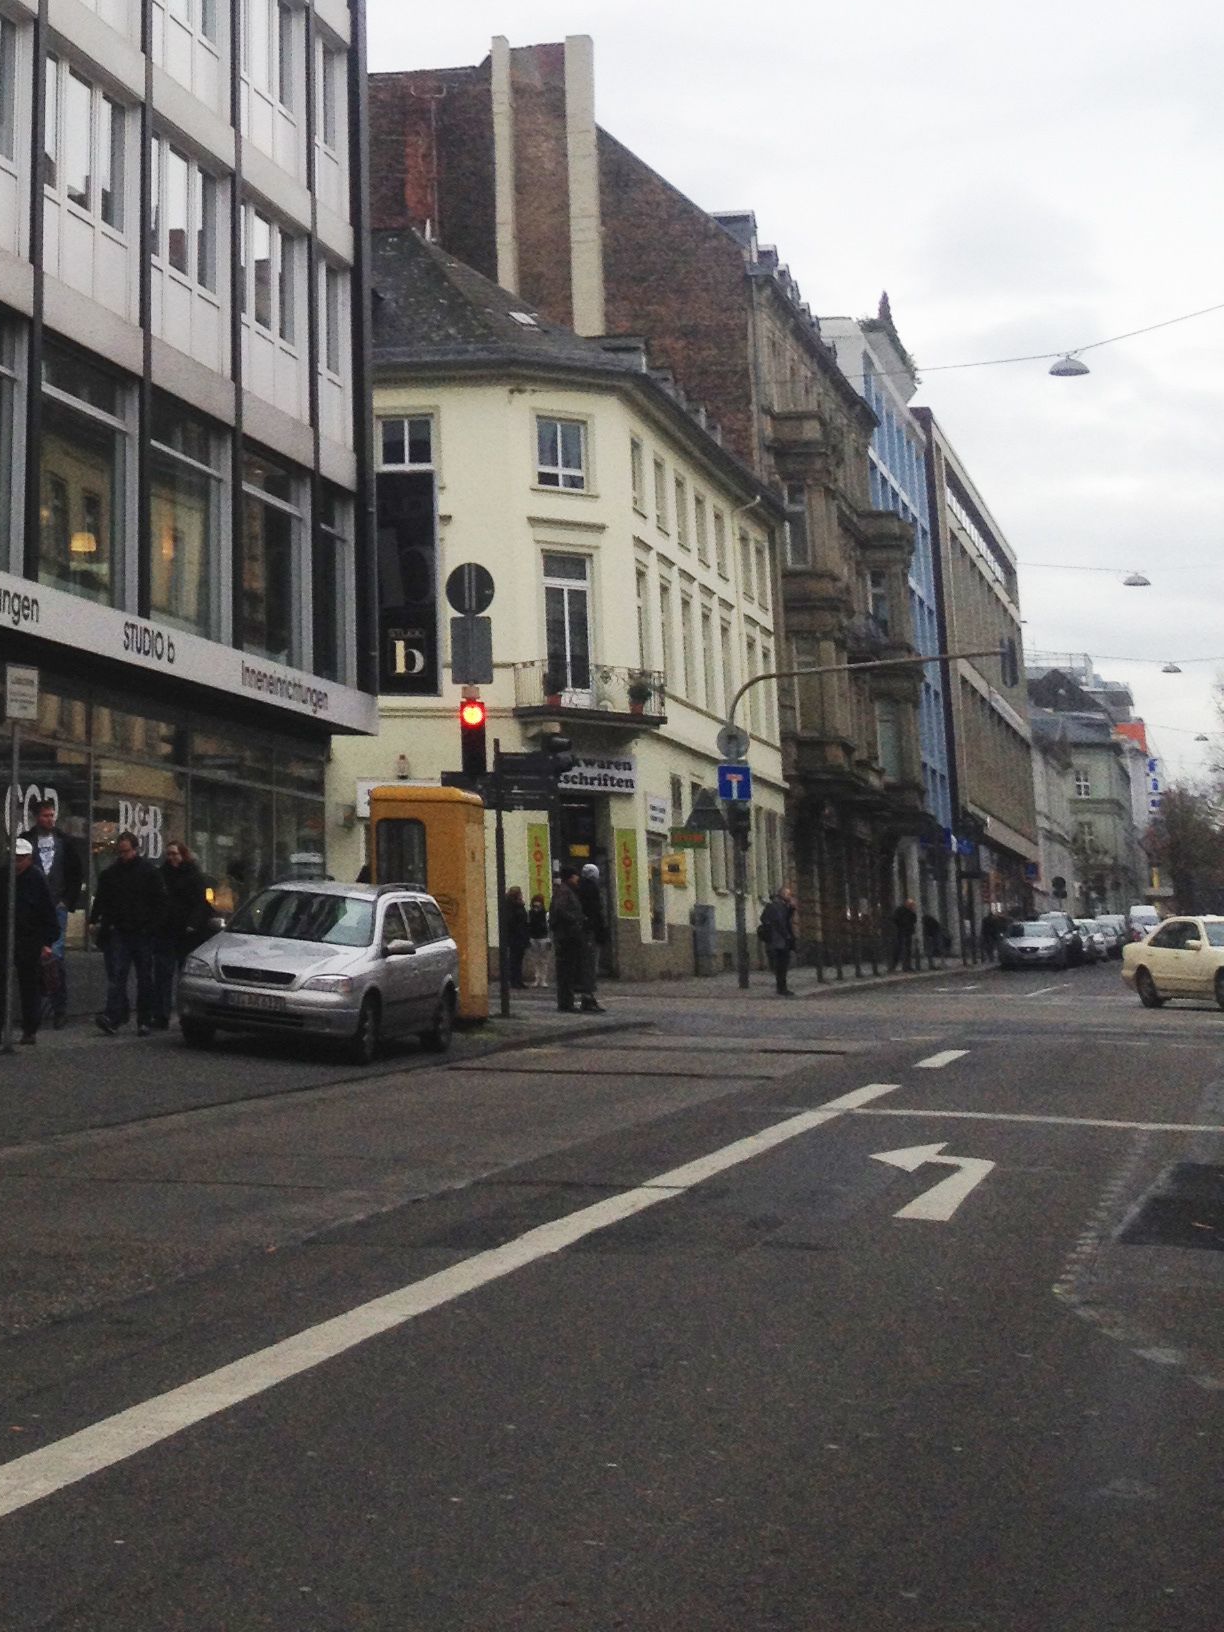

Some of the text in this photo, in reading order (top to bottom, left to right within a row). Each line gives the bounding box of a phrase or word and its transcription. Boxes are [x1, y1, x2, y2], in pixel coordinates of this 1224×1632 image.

[122, 620, 175, 665] STUDIO b
[393, 639, 425, 674] b
[570, 753, 633, 772] kwaren
[559, 771, 635, 789] schriften
